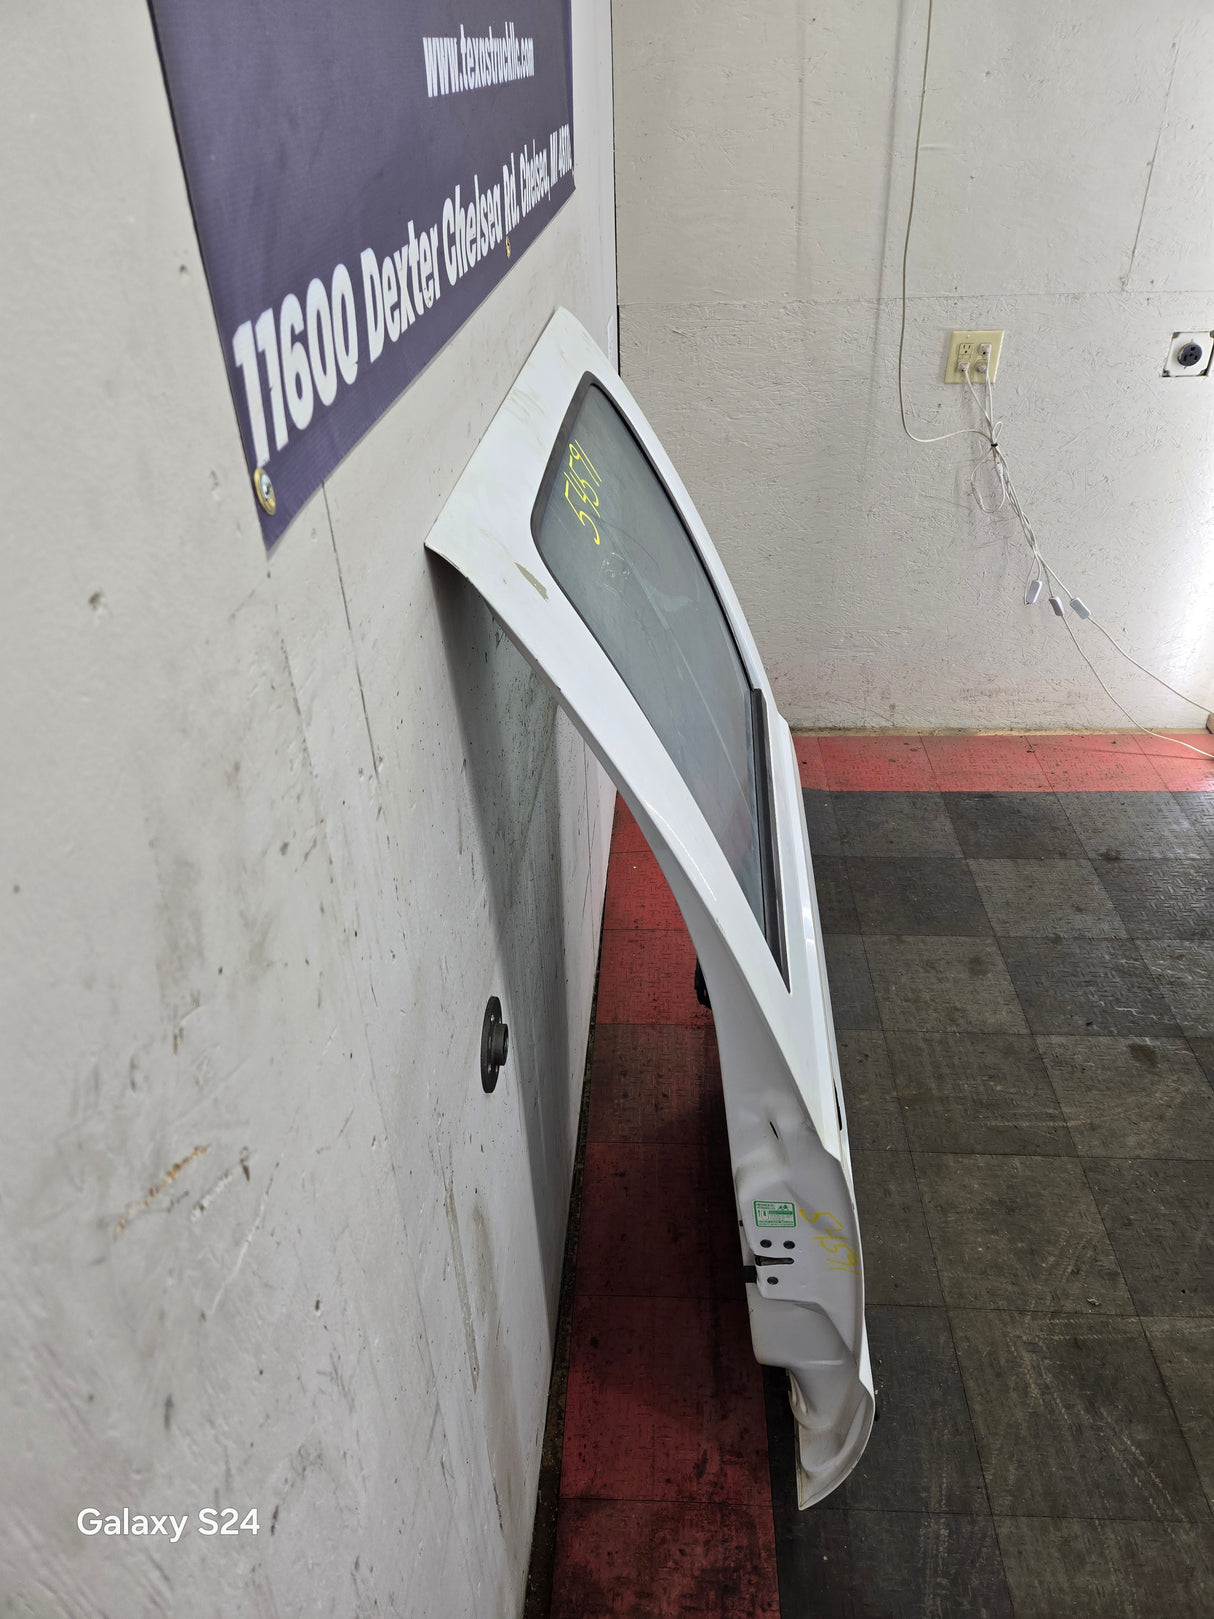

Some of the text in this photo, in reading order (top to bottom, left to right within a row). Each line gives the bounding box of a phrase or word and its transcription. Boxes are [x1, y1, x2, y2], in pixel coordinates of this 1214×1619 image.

[232, 263, 359, 468] 11600
[360, 219, 441, 364] Dexter
[442, 174, 503, 286] Chelsea
[503, 152, 520, 235] Rd.
[563, 439, 602, 545] 54591
